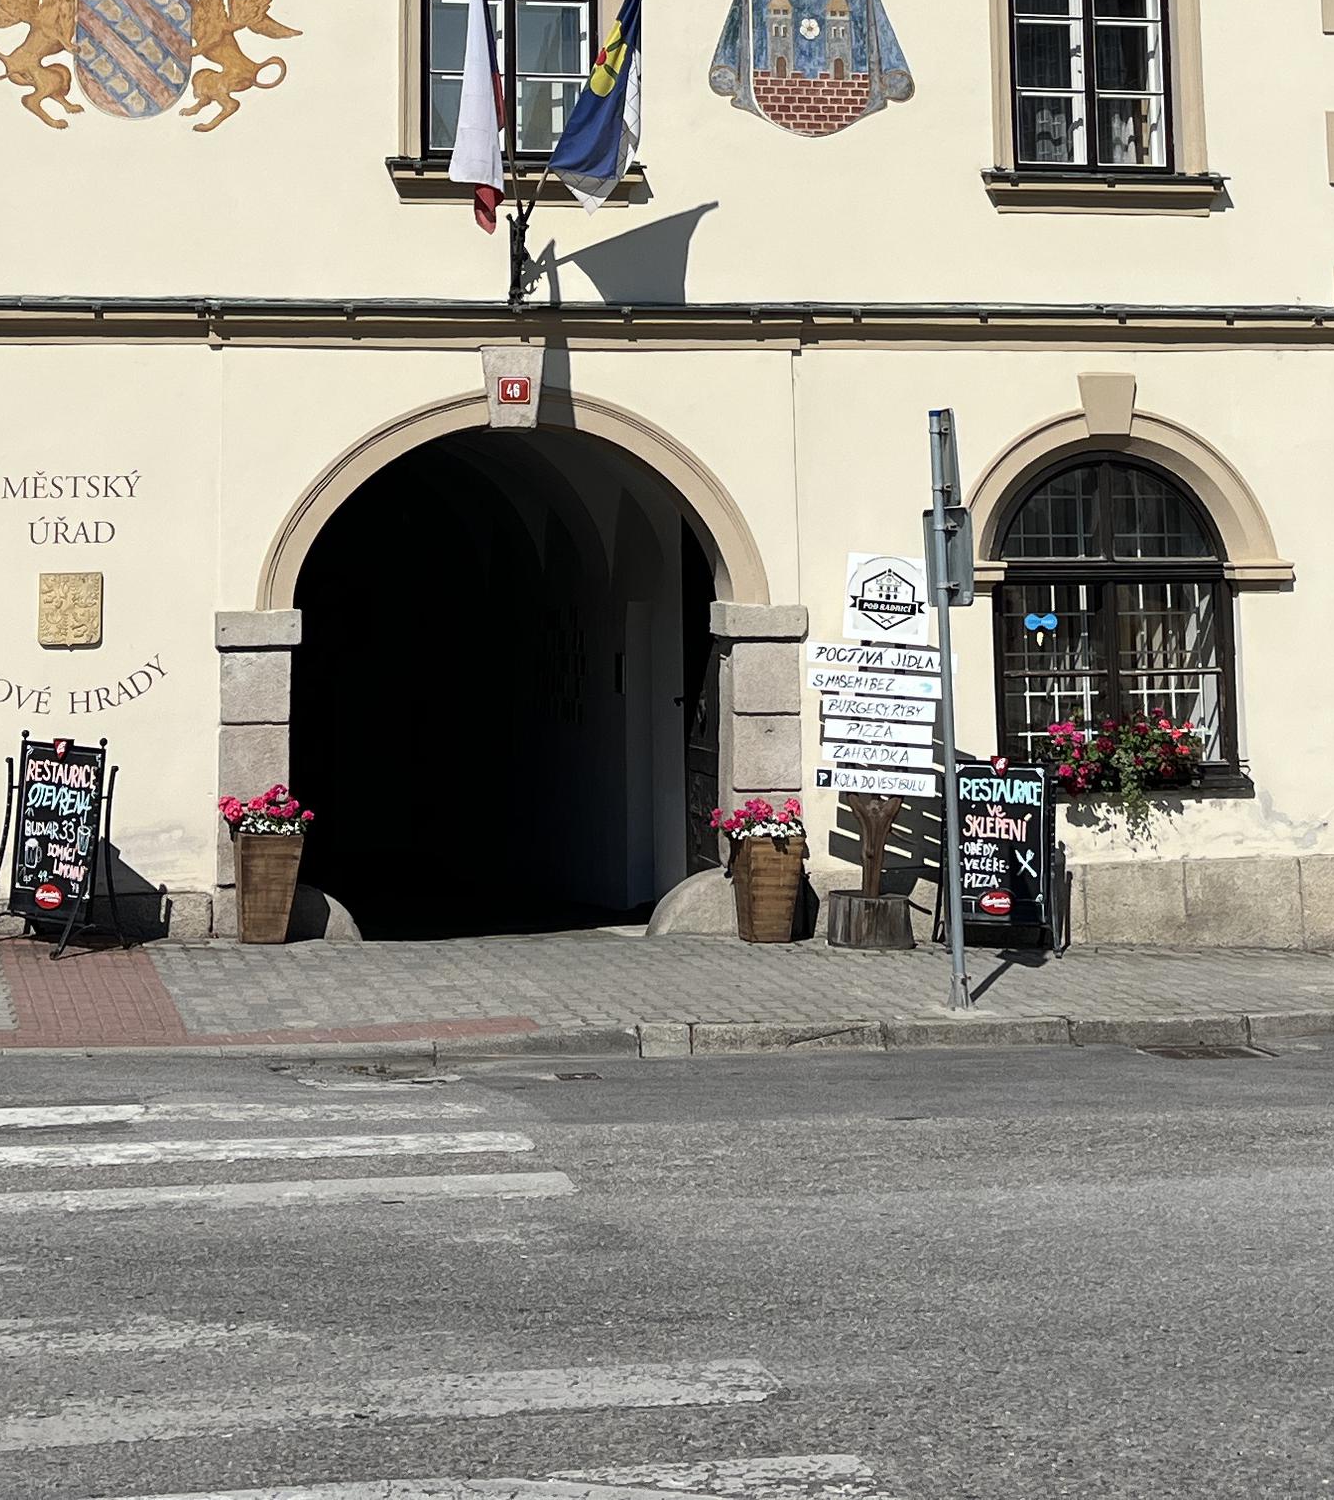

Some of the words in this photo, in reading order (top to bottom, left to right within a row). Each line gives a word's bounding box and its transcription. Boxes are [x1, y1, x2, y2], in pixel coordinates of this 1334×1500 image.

[1, 470, 142, 500] MĚSTSKÝ
[28, 516, 116, 545] ÚŘAD
[815, 646, 888, 666] POCTIVÁ
[68, 653, 168, 715] HRADY
[846, 722, 893, 739] PIZZA
[963, 872, 999, 889] PIZZA
